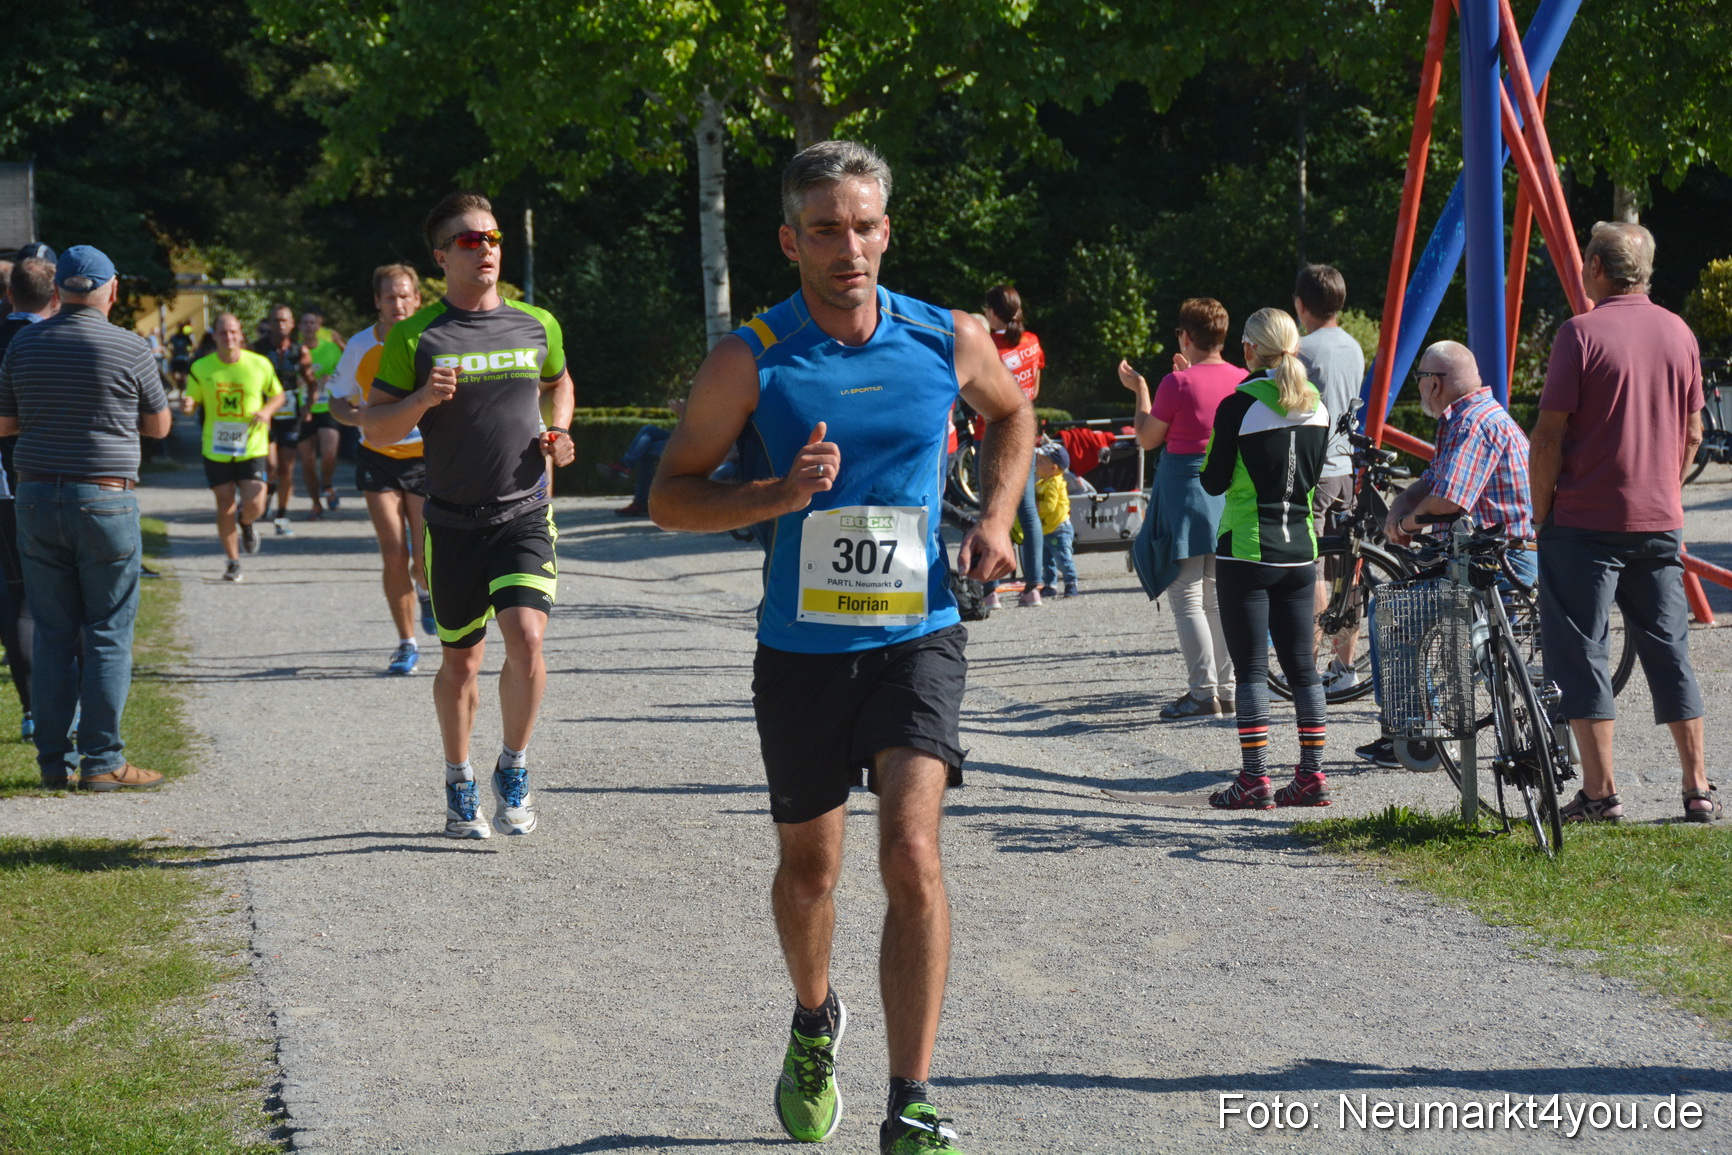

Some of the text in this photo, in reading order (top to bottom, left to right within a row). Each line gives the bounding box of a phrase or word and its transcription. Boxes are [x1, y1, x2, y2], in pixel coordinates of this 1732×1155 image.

[433, 349, 539, 374] BOCK
[483, 373, 508, 382] smart
[224, 396, 237, 409] M
[840, 516, 893, 528] BOCK
[832, 537, 898, 575] 307
[827, 578, 891, 588] PARTL Neumarkt
[838, 595, 889, 611] Florian
